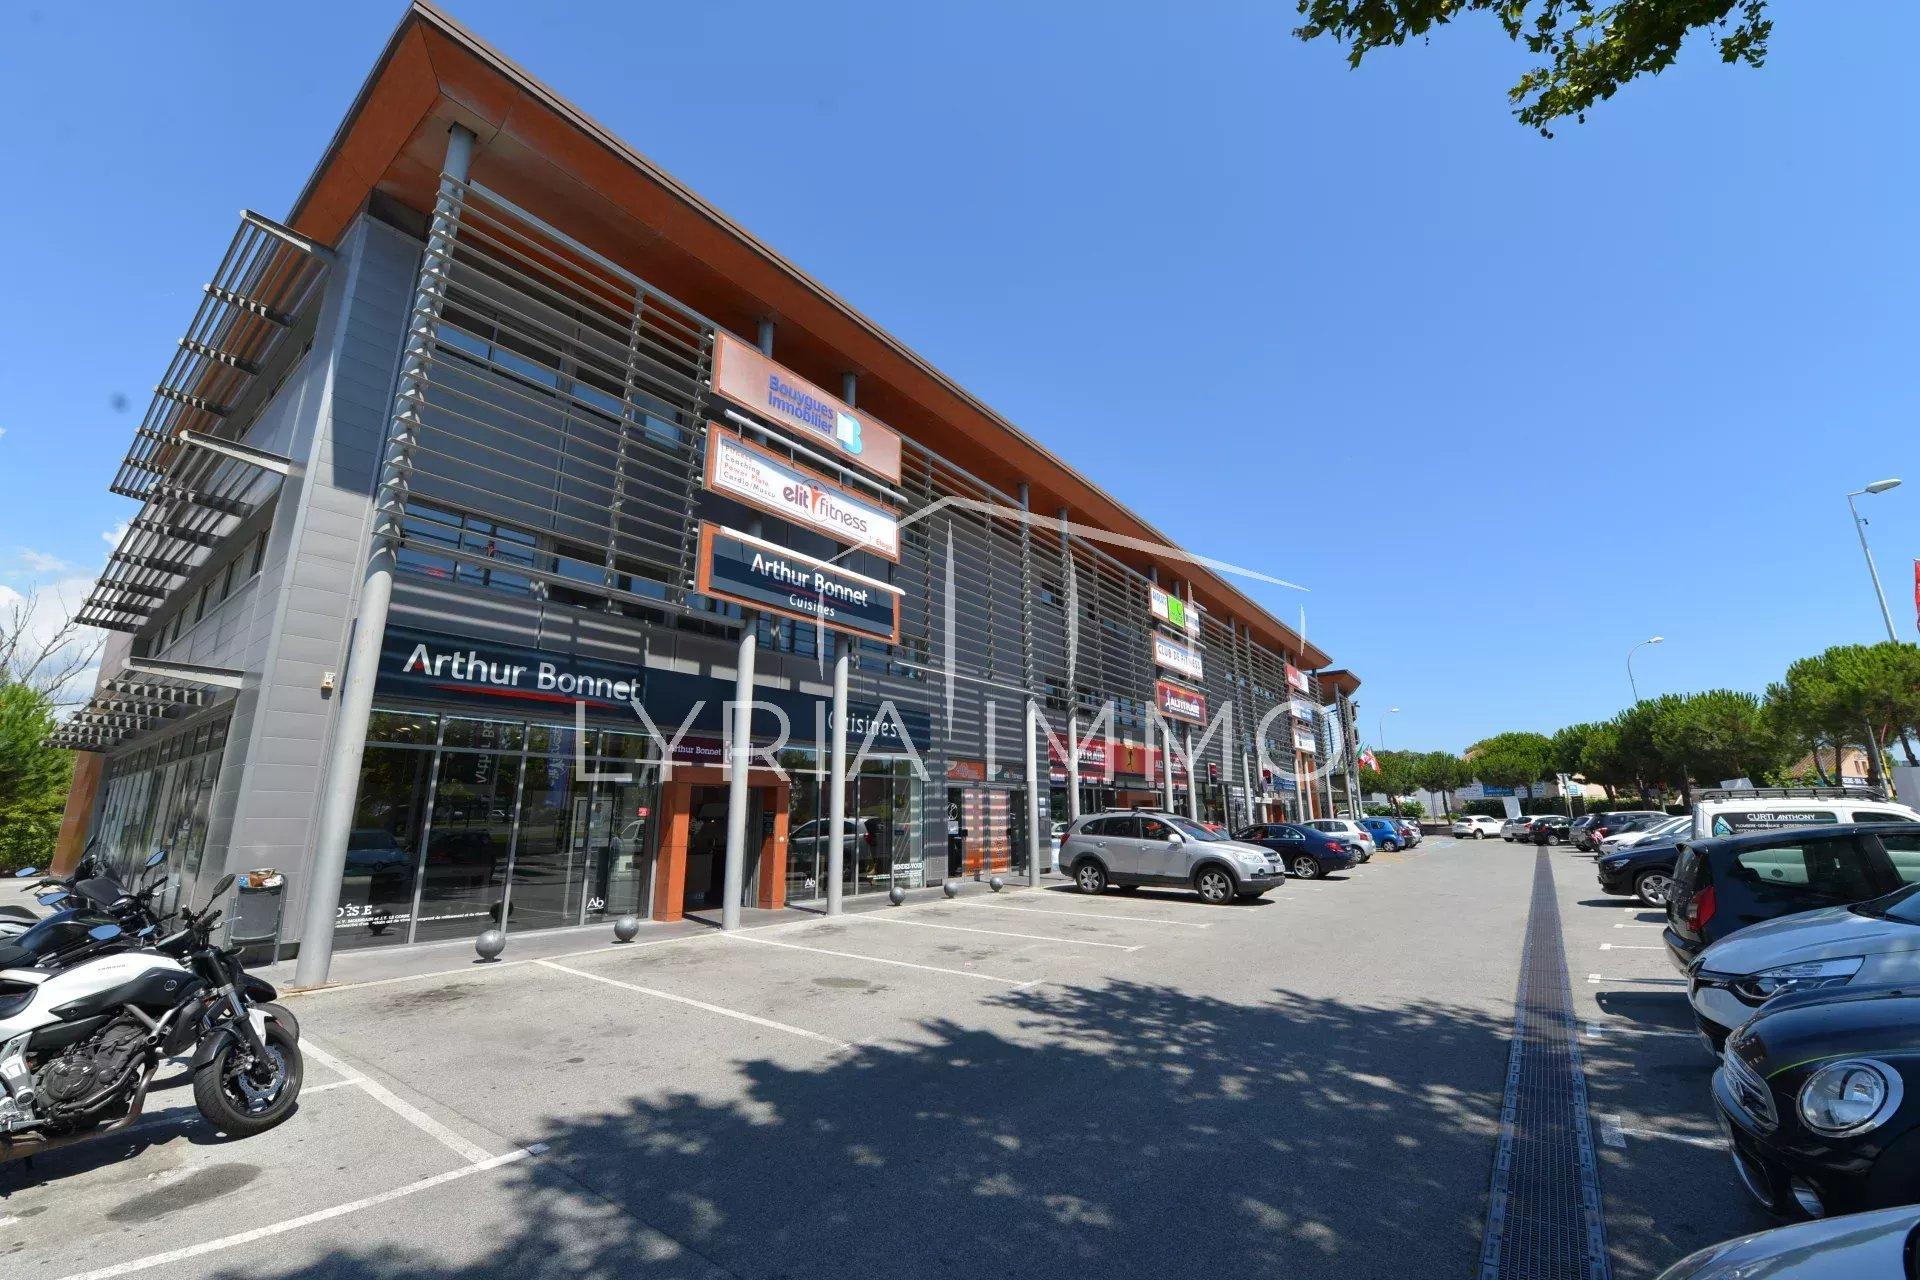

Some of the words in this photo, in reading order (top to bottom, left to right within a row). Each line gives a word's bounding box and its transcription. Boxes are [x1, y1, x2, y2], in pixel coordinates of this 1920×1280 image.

[768, 390, 833, 435] Immobilier
[769, 374, 834, 420] Bouygues
[725, 454, 760, 475] Coaching
[783, 484, 809, 509] elit
[820, 497, 867, 532] fitness
[750, 553, 810, 588] Arthur
[814, 573, 868, 607] Bonnet
[789, 594, 835, 617] Cuisines
[402, 643, 528, 686] Arthur
[537, 661, 641, 701] Bonnet
[668, 743, 693, 754] Arthur
[695, 746, 722, 756] Bonnet
[587, 897, 605, 909] Ab
